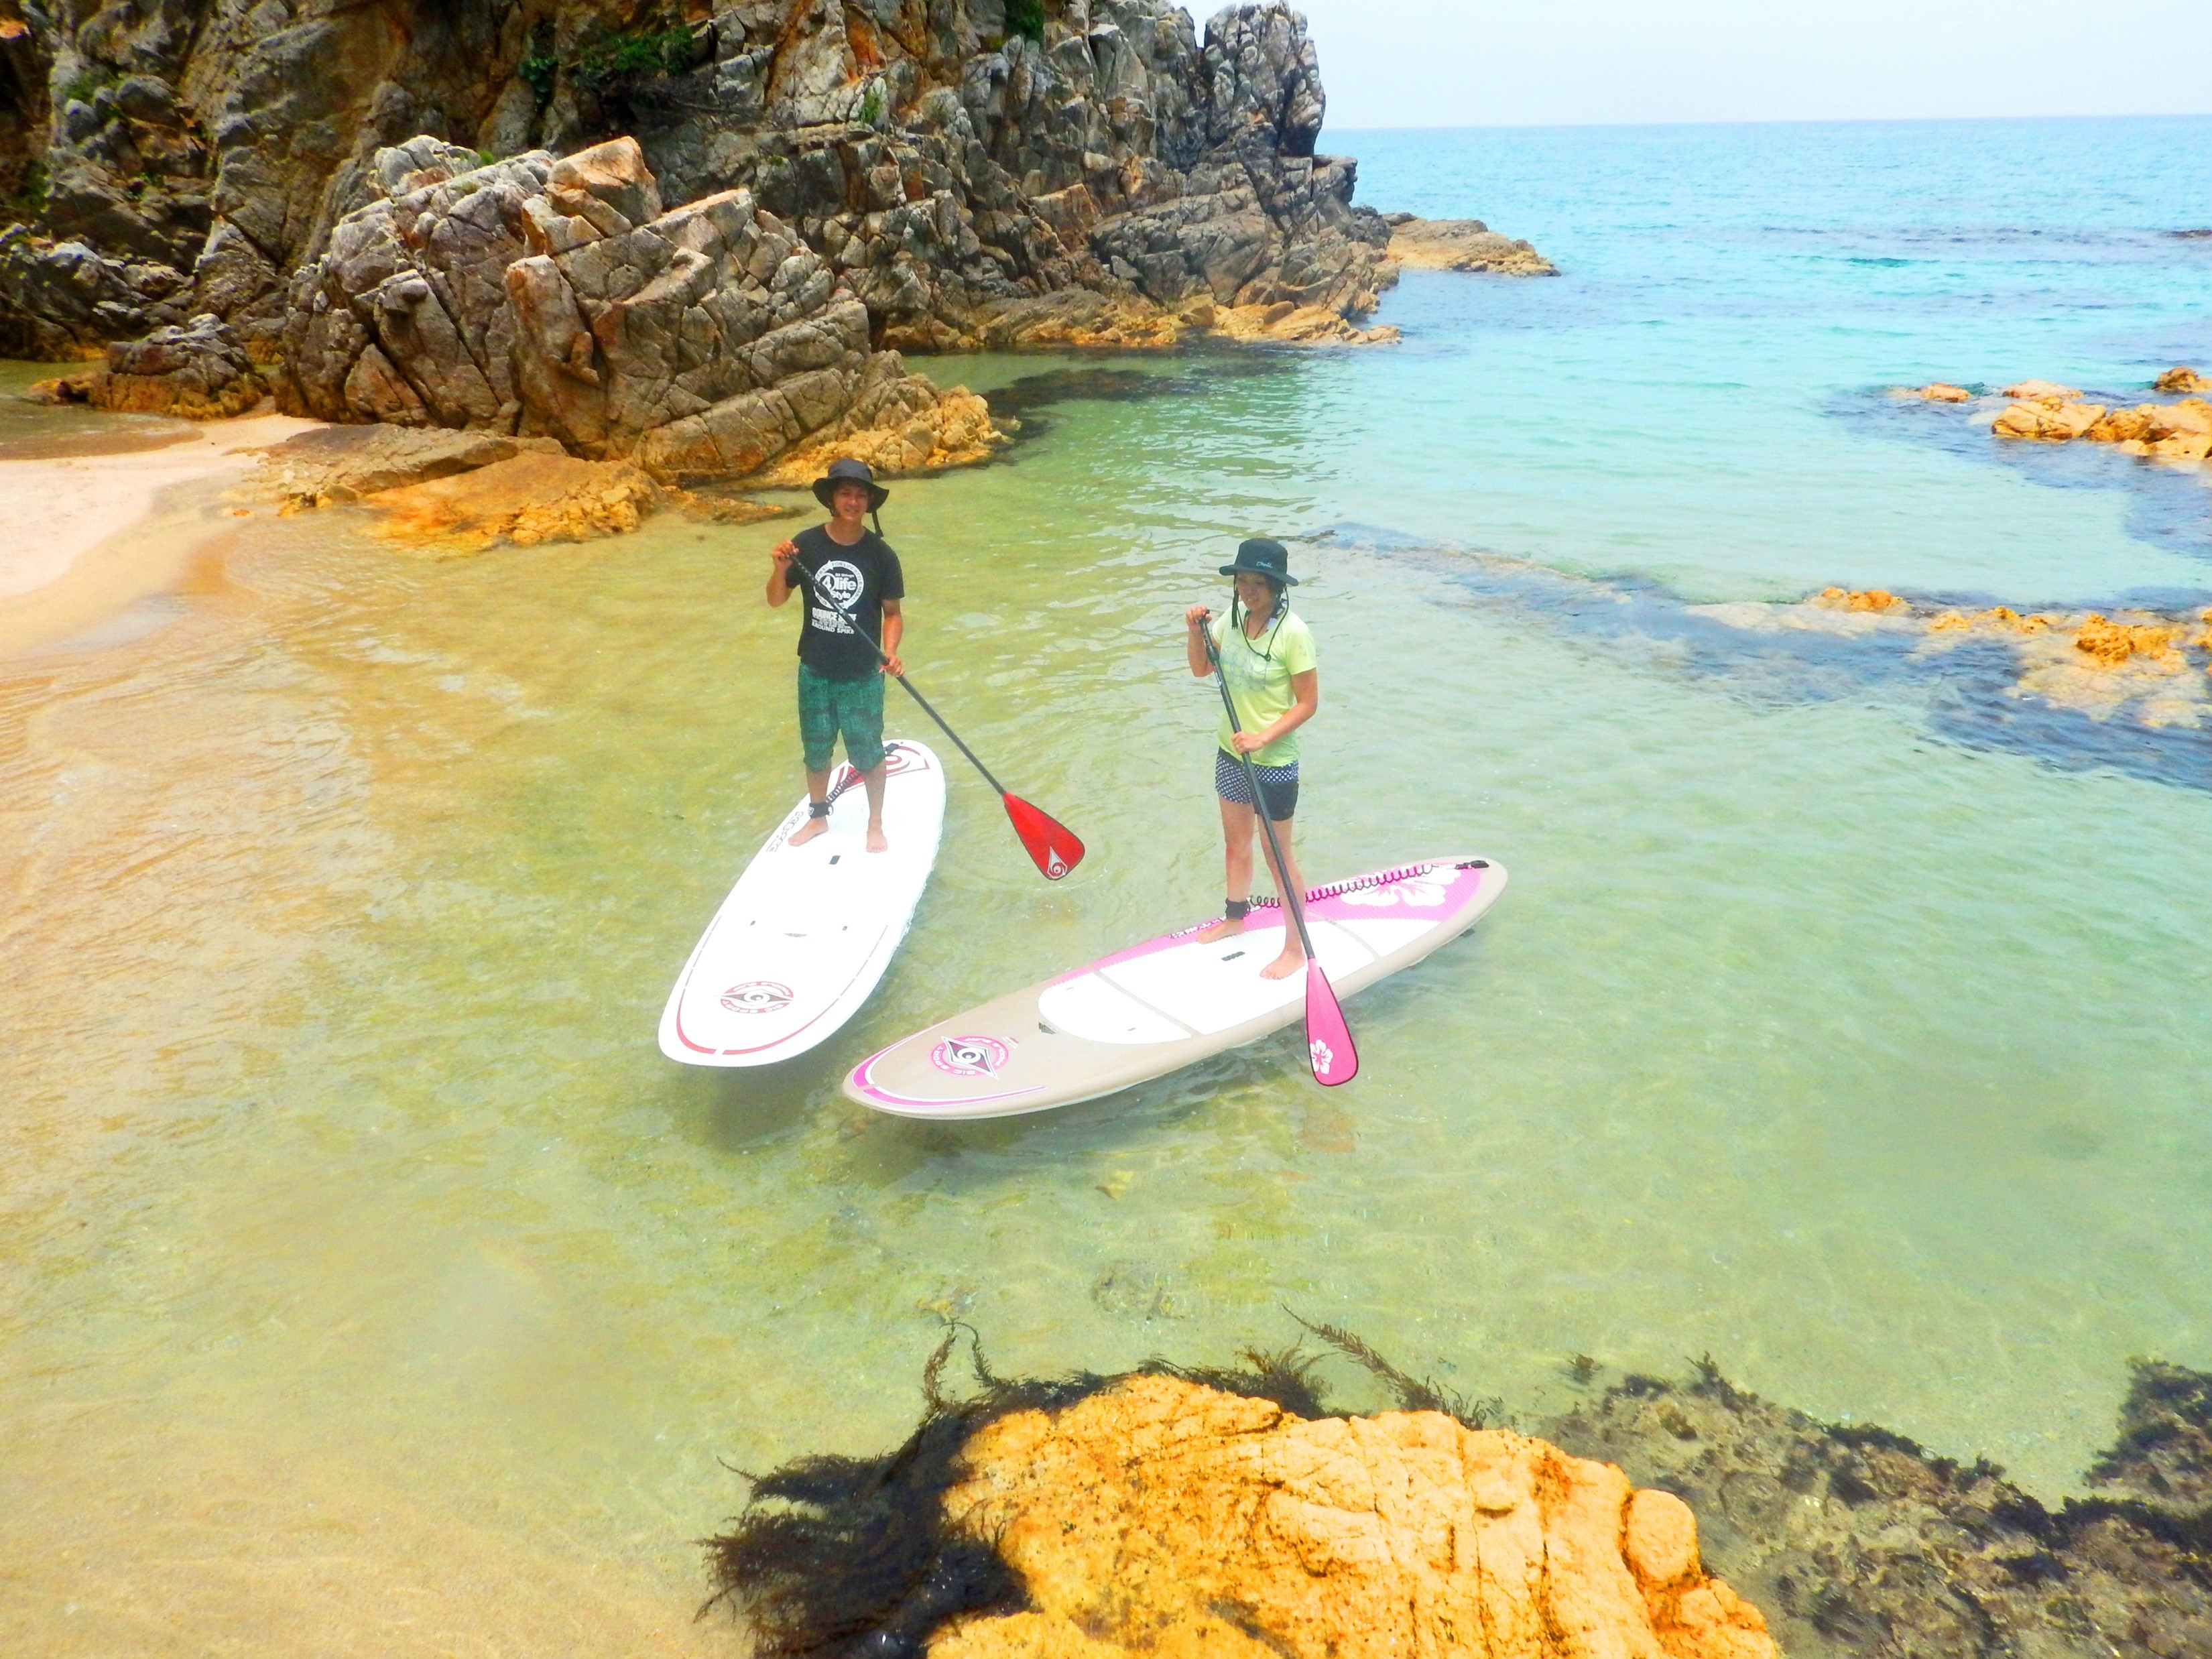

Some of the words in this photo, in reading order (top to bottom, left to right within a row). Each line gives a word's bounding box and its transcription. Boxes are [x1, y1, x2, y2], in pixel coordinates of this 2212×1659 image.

[822, 575, 832, 591] 4
[835, 577, 857, 591] life
[812, 607, 838, 622] BOUNCE
[932, 1045, 950, 1070] SPORT
